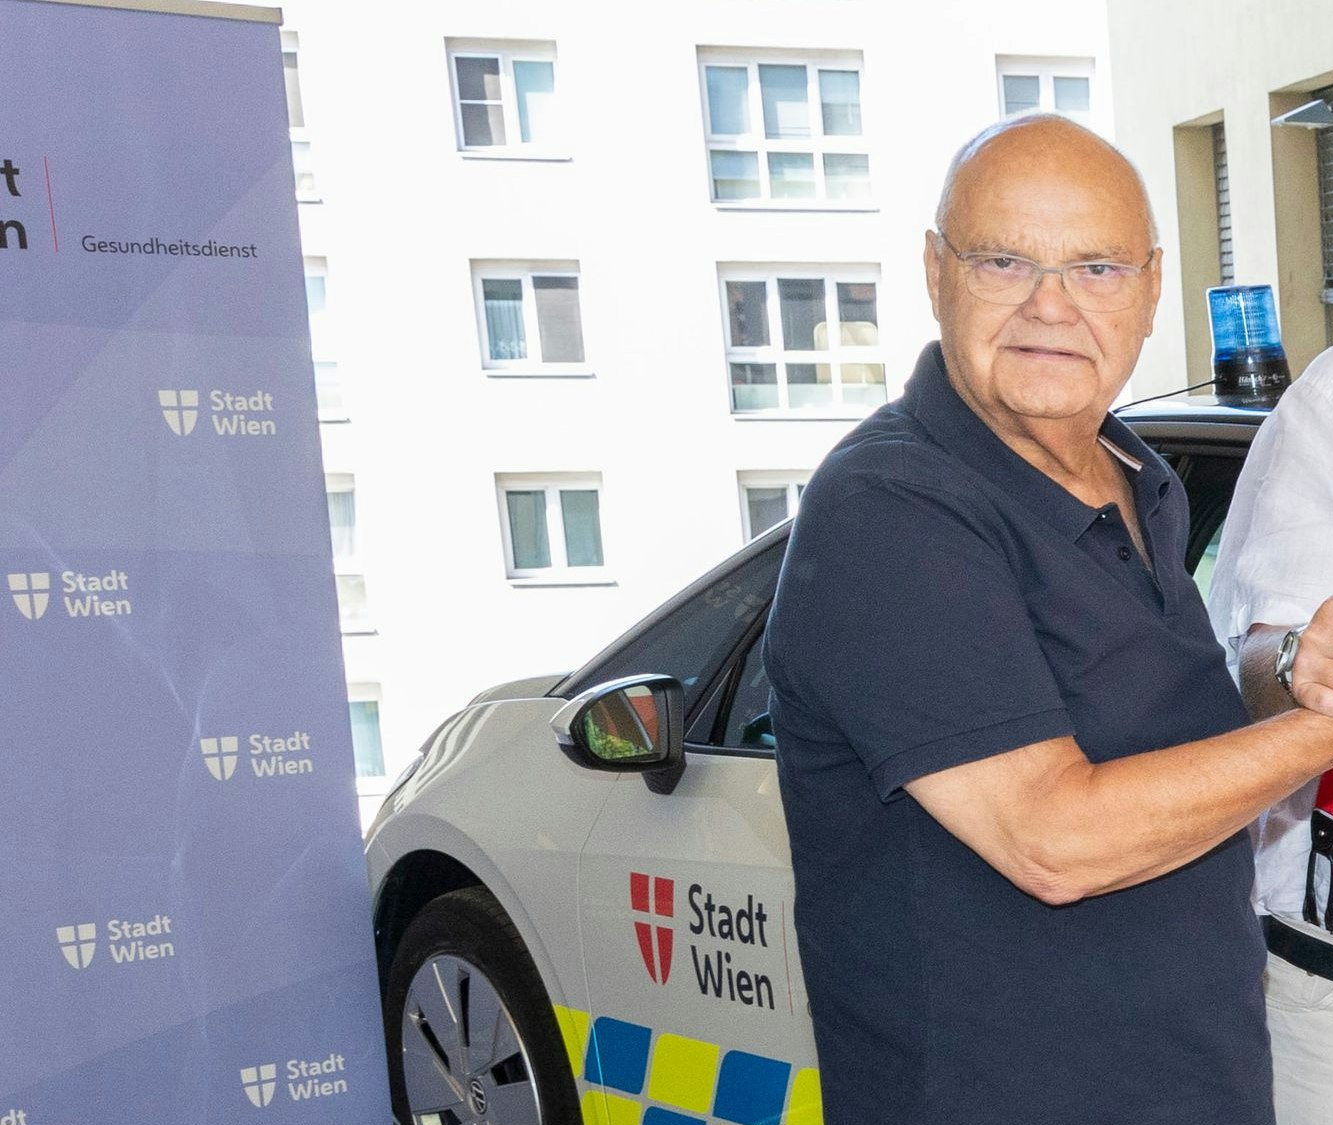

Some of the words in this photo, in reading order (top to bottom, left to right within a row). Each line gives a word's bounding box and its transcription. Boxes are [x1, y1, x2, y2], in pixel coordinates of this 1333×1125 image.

[81, 235, 258, 259] Gesundheitsdienst
[209, 388, 273, 413] Stadt
[211, 414, 276, 437] Wien
[61, 569, 129, 593] Stadt
[64, 593, 132, 617] Wien
[249, 731, 311, 755] Stadt
[251, 754, 313, 778] Wien
[107, 915, 173, 940] Stadt
[688, 883, 768, 948] Stadt
[109, 939, 175, 965] Wien
[690, 944, 775, 1011] Wien
[286, 1053, 346, 1079] Stadt
[287, 1076, 348, 1102] Wien
